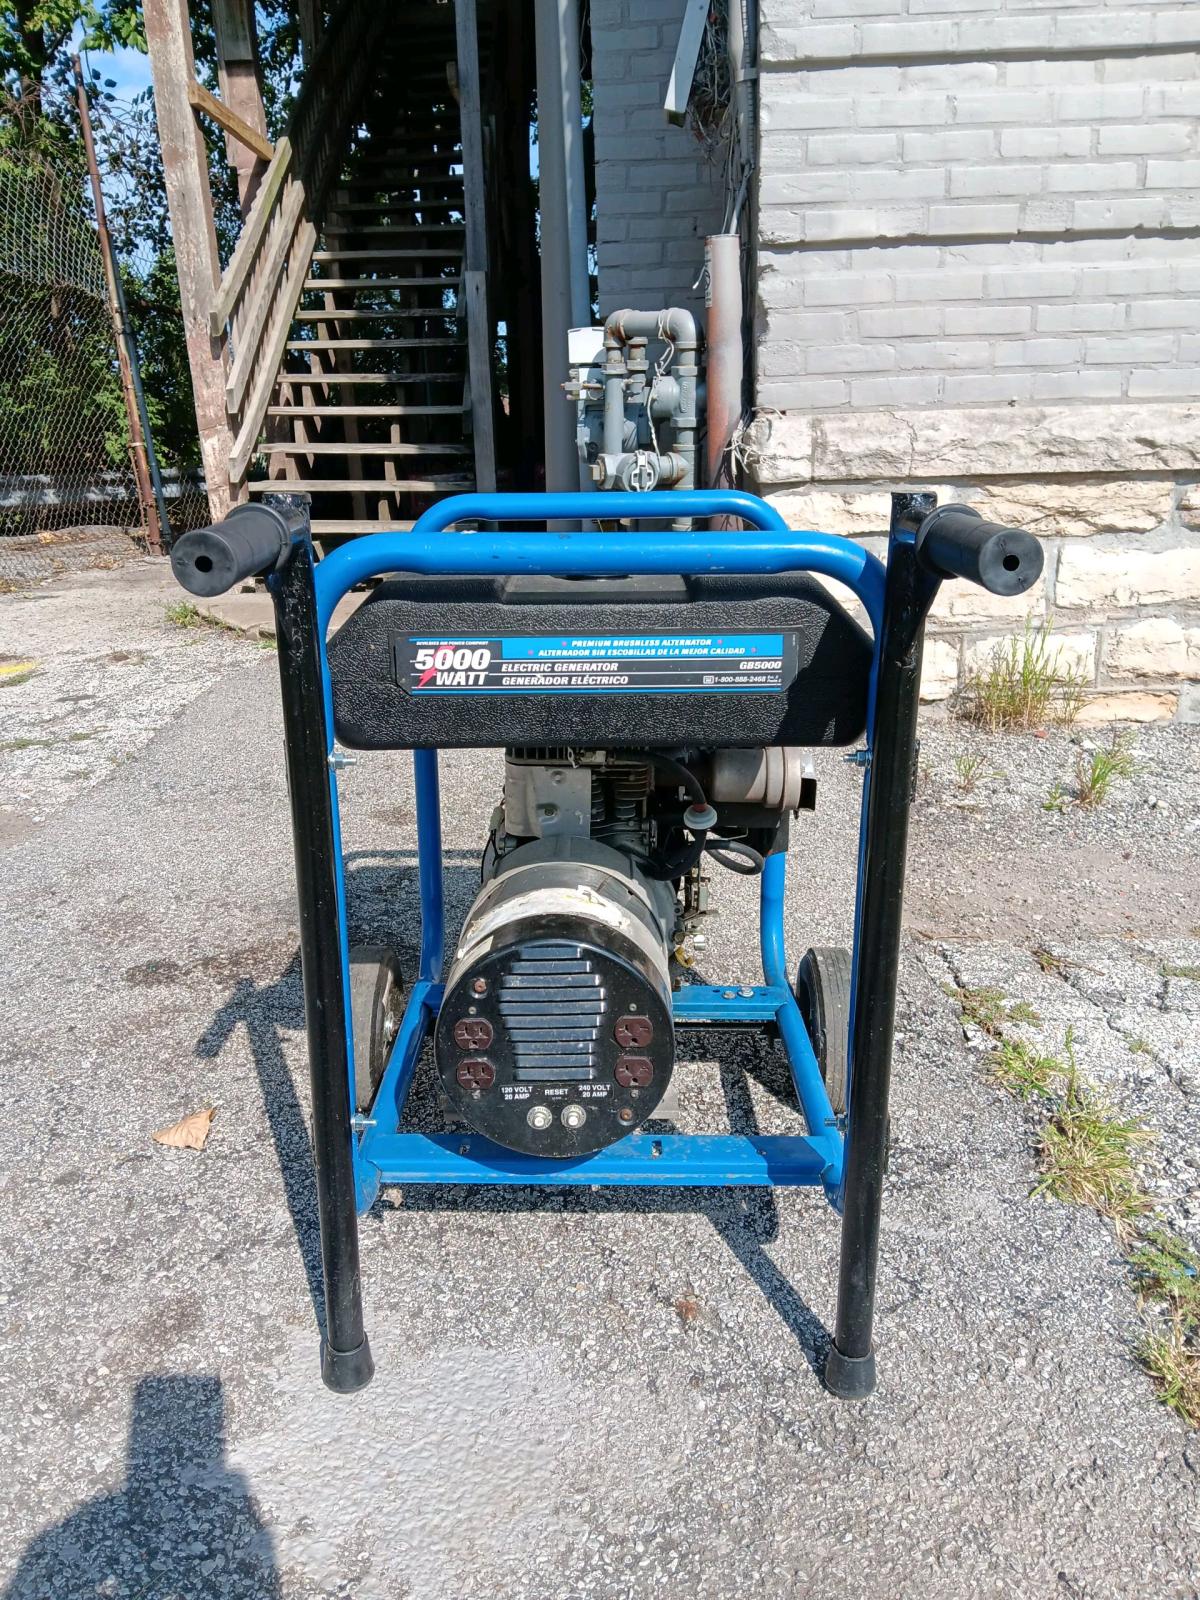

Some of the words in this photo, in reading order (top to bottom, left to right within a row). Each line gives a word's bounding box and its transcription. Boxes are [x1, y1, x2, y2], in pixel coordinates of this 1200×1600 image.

[613, 639, 660, 647] BRUSHLESS
[607, 648, 656, 656] ESCOBILLAS
[710, 647, 746, 655] CALIDAD
[414, 648, 492, 670] 5000
[501, 663, 552, 672] ELECTRIC
[554, 662, 619, 672] GENERATOR
[739, 661, 782, 670] GB5000
[435, 671, 489, 686] WATT
[502, 677, 569, 686] GENERADOR
[570, 674, 629, 685] ELÉCTRICO
[501, 1086, 512, 1094] 120
[578, 1084, 591, 1092] 240
